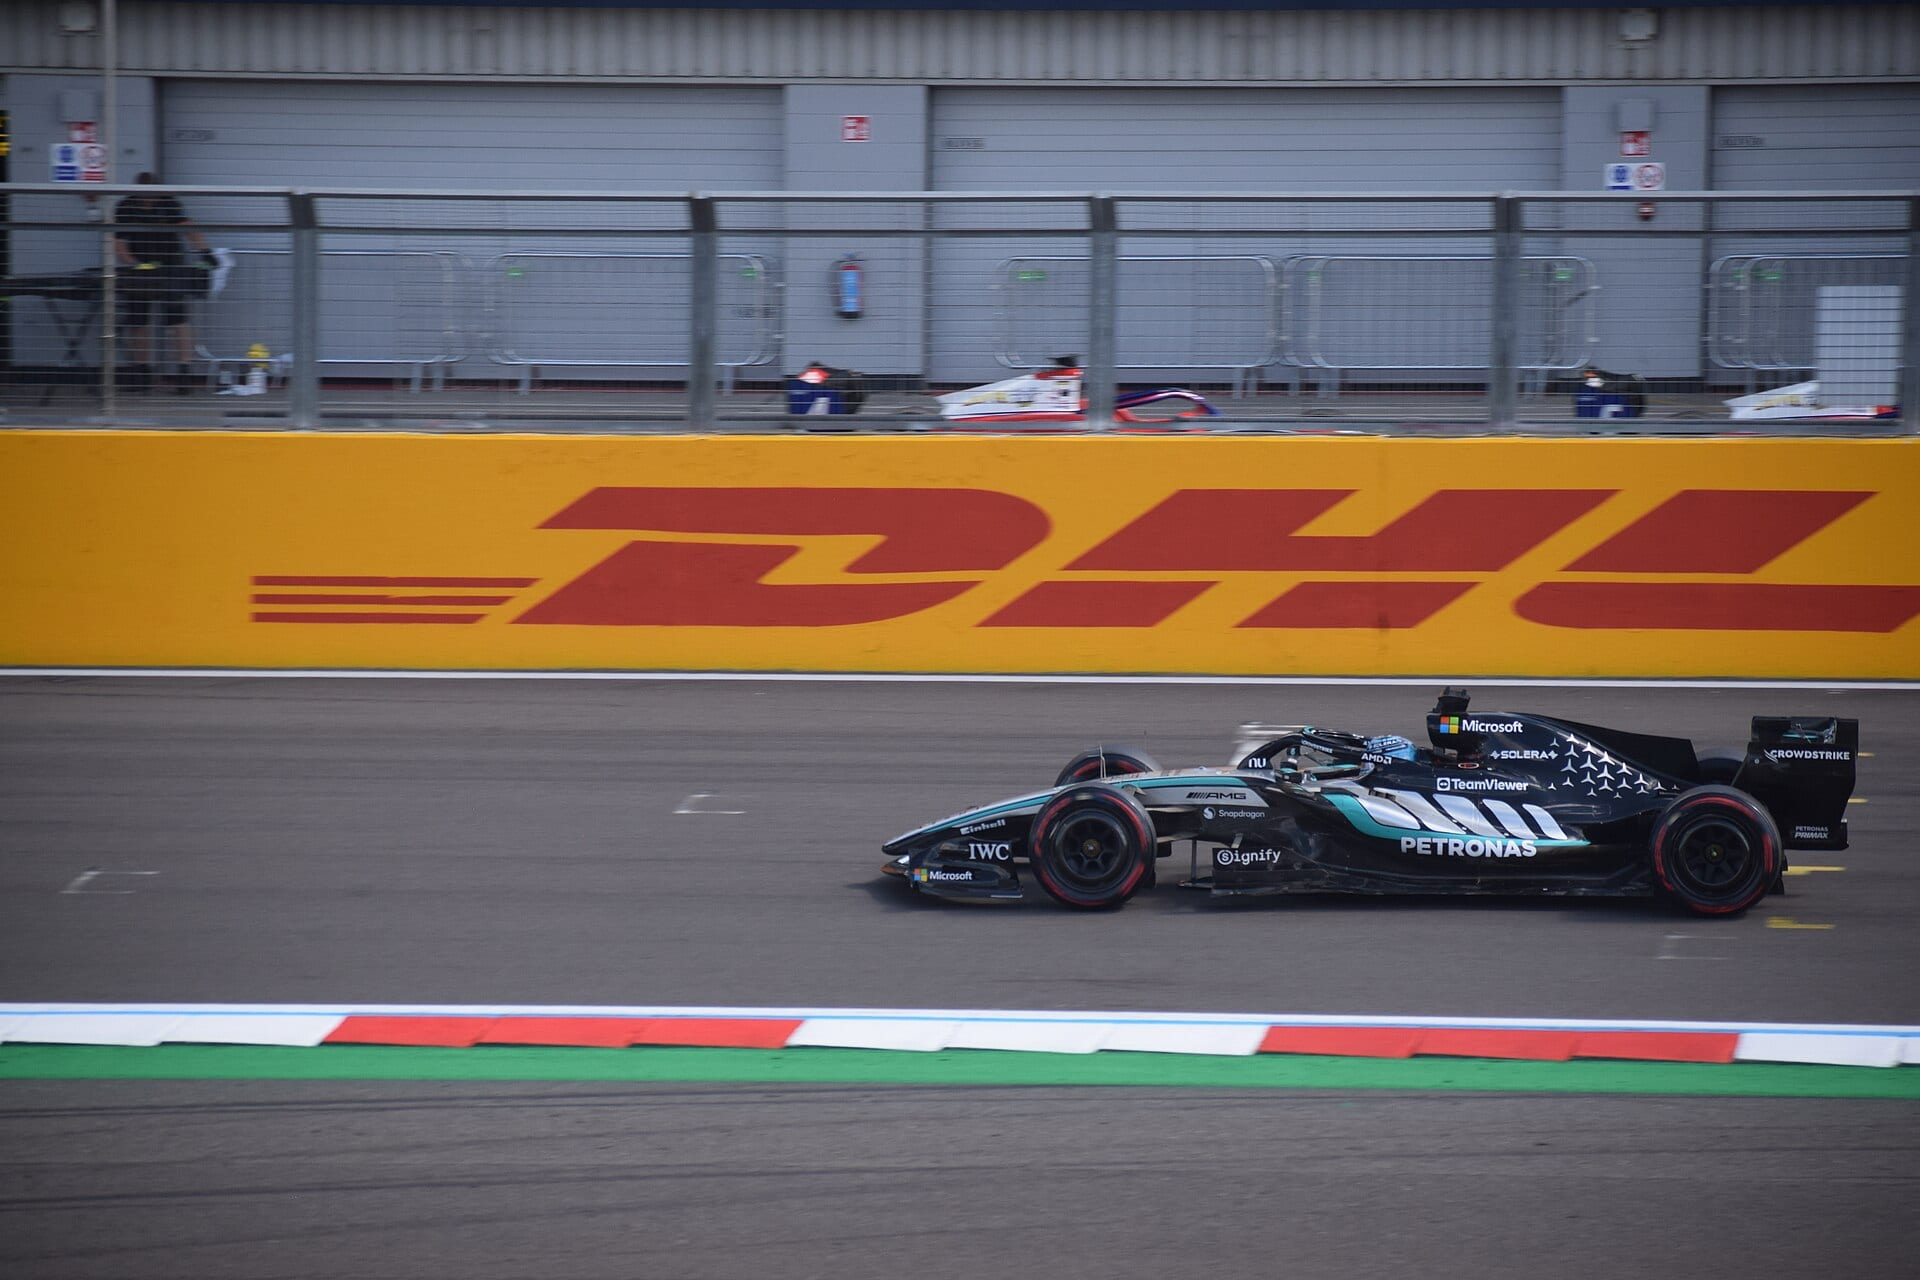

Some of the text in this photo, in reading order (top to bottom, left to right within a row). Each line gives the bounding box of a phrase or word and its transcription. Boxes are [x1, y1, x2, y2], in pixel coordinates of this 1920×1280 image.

[510, 487, 1920, 633] DHL
[1462, 719, 1523, 733] Microsoft
[1361, 752, 1384, 764] AMD
[1500, 750, 1549, 759] SOLERA
[1769, 749, 1851, 760] CROWDSTRIKE
[1451, 778, 1529, 791] TeamViewer
[1205, 792, 1247, 800] AMG
[1218, 809, 1266, 819] Snapdragon
[968, 843, 1010, 860] IWC
[1400, 837, 1537, 858] PETRONAS
[929, 871, 973, 880] Microsoft
